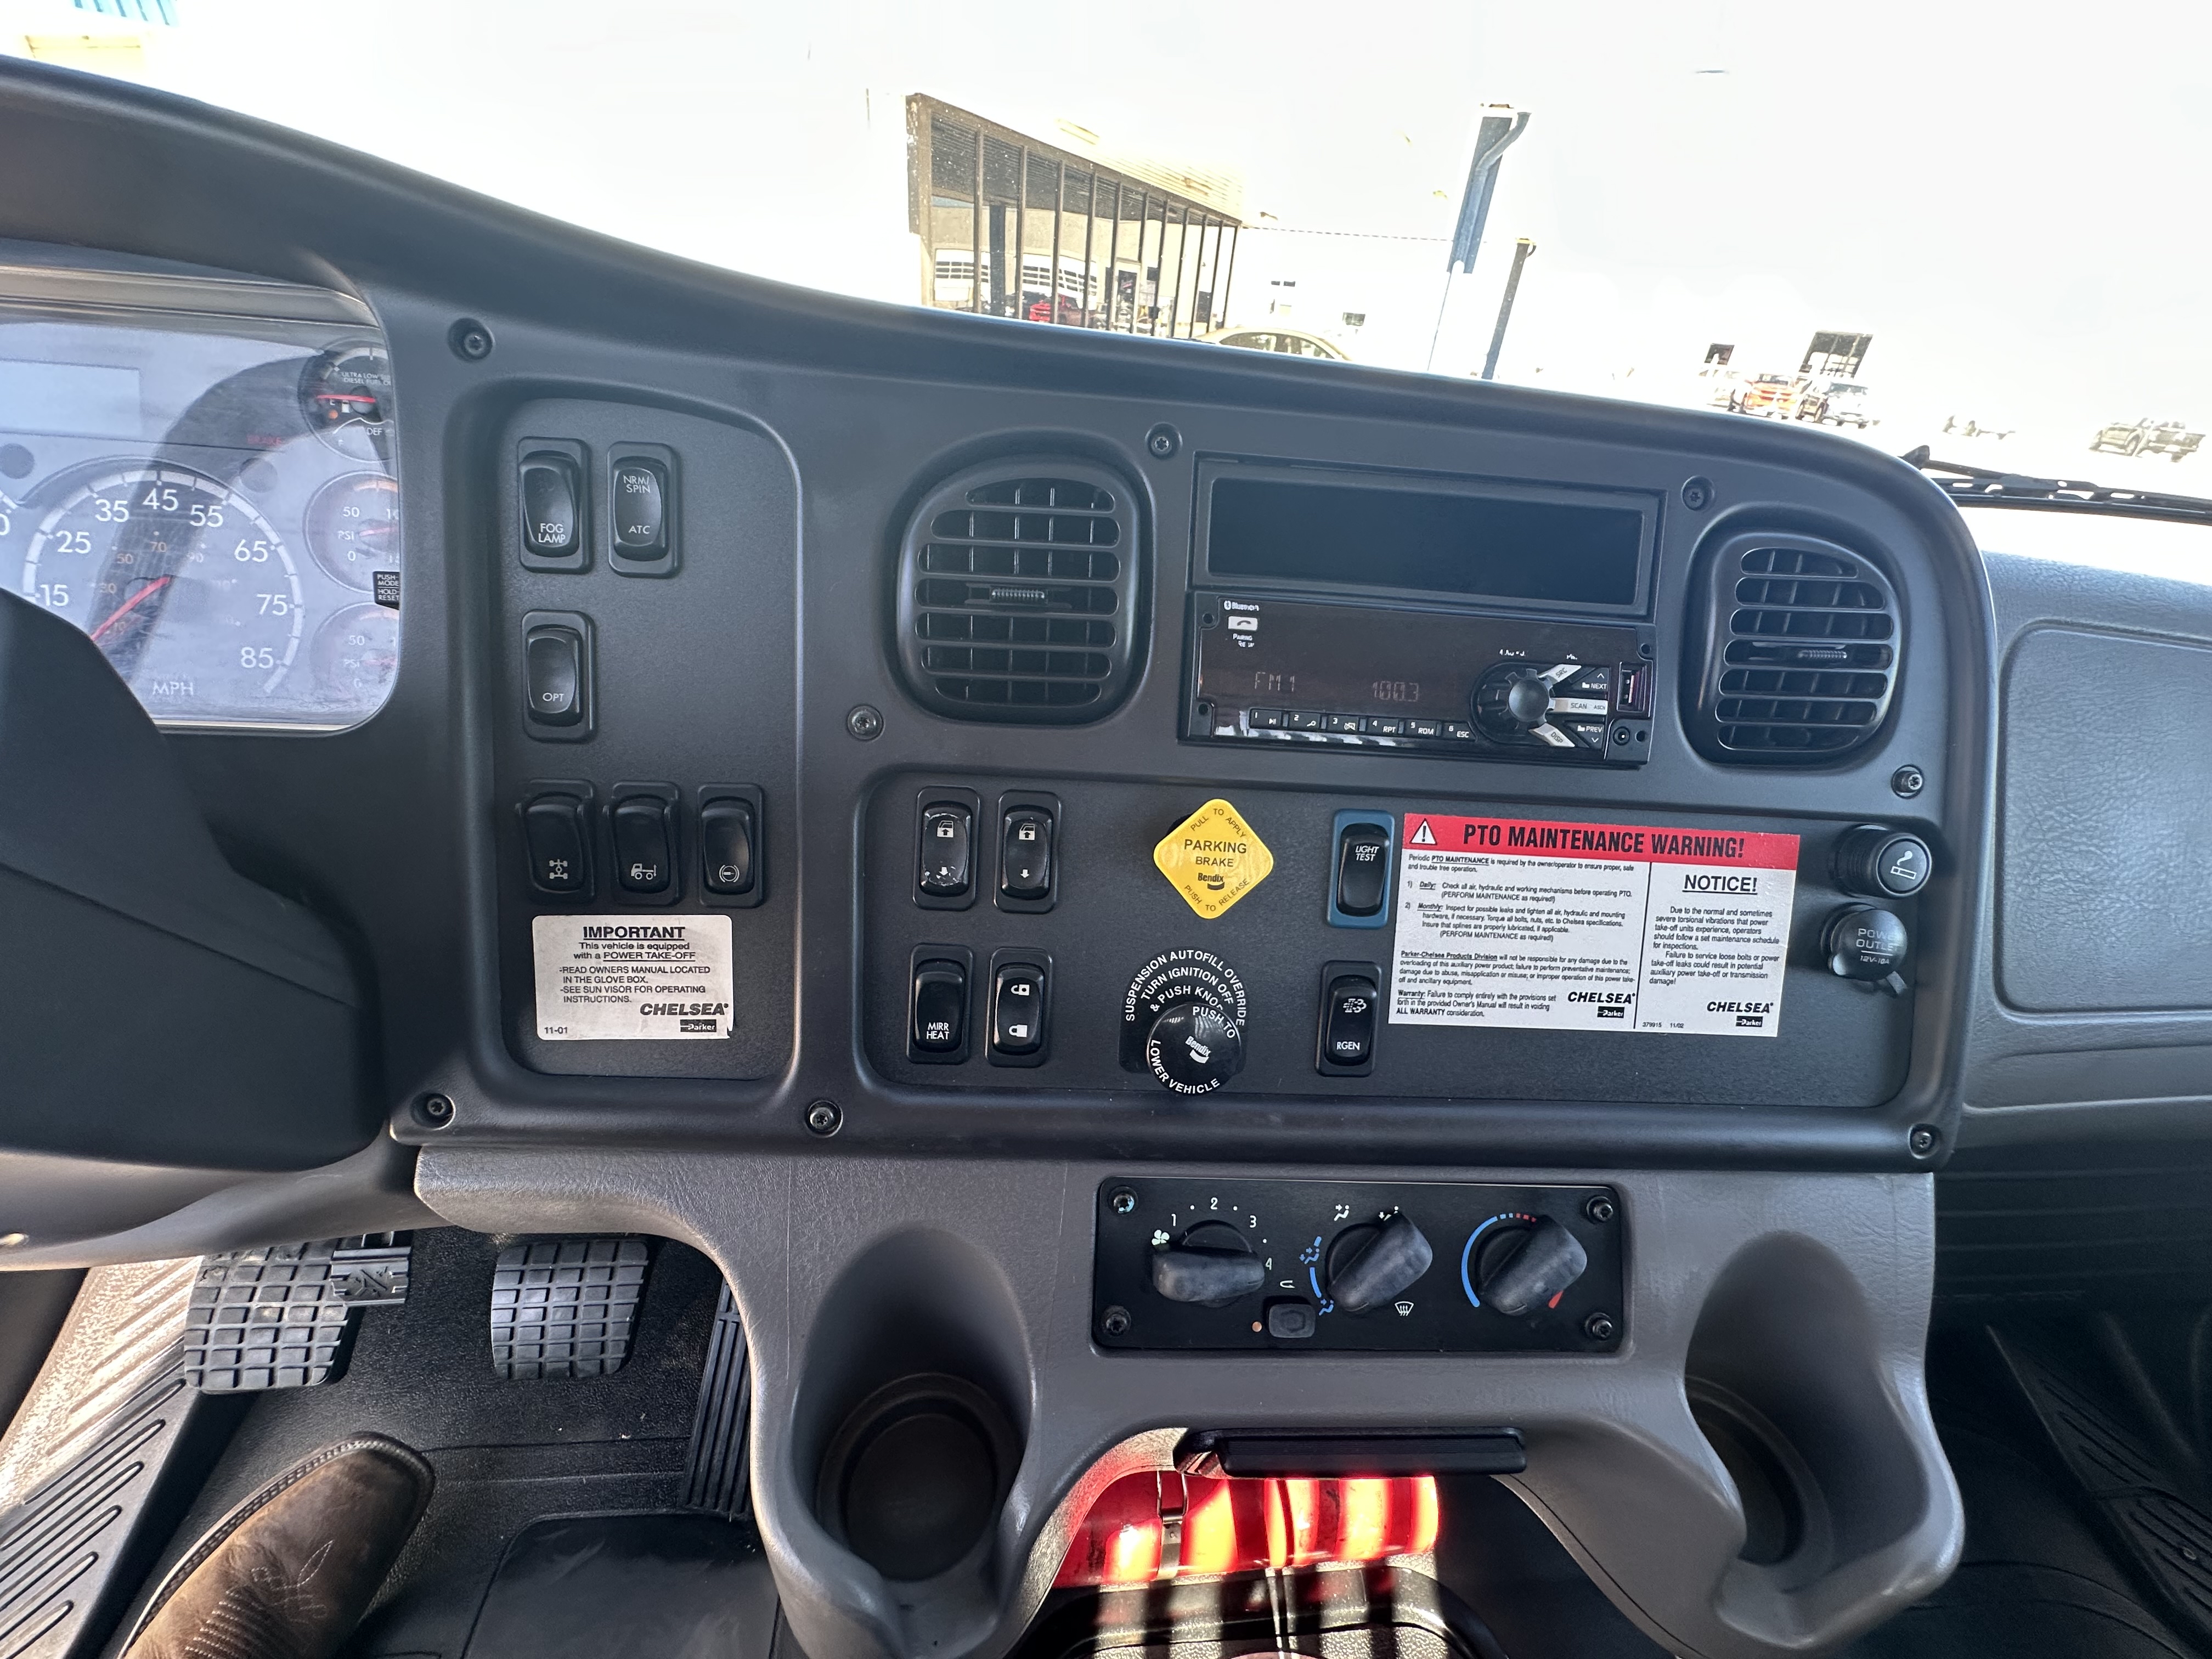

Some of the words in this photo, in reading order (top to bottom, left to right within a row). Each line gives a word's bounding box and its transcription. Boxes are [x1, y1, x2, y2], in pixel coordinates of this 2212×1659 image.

[366, 427, 382, 436] DEF
[623, 476, 650, 486] NRM/
[626, 484, 651, 494] SPIN
[143, 489, 178, 510] 45
[95, 500, 129, 522] 35
[189, 505, 224, 528] 55
[343, 506, 360, 517] 50
[540, 523, 563, 533] FOG
[628, 525, 650, 534] ATC
[338, 531, 354, 540] PSI
[538, 533, 566, 543] LAMP
[57, 531, 91, 554] 25
[150, 542, 167, 552] 70
[234, 540, 268, 562] 65
[347, 551, 356, 561] 0
[117, 554, 133, 564] 50
[40, 584, 69, 606] 15
[256, 594, 288, 616] 75
[348, 635, 365, 646] 50
[240, 647, 274, 669] 85
[1555, 667, 1568, 678] SRC
[153, 682, 194, 695] MPH
[542, 693, 564, 701] OPT
[1550, 731, 1563, 743] DISP
[1190, 816, 1210, 832] PULL
[1225, 817, 1246, 838] APPLY
[1184, 839, 1247, 854] PARKING
[1463, 824, 1500, 845] PTO
[1508, 826, 1645, 853] MAINTENANCE
[1651, 834, 1745, 858] WARNING!
[1356, 845, 1379, 854] LIGHT
[1195, 856, 1234, 867] BRAKE
[1356, 853, 1376, 862] TEST
[1198, 872, 1224, 882] Bendix
[1684, 873, 1757, 892] NOTICE!
[1184, 885, 1203, 904] PUSH
[1218, 878, 1250, 906] RELEASE
[1441, 890, 1475, 899] (PERFORM
[1475, 892, 1520, 901] MAINTENANCE
[1528, 895, 1556, 904] required!)
[1677, 915, 1704, 924] torsional
[1705, 916, 1735, 925] vibrations
[583, 926, 685, 938] IMPORTANT
[1654, 923, 1678, 932] take-off
[1695, 926, 1731, 934] experience,
[1653, 932, 1675, 940] should
[1675, 933, 1694, 941] follow
[1752, 936, 1780, 944] schedule
[647, 943, 690, 952] equipped
[1662, 942, 1699, 950] inspections.
[1860, 955, 1889, 964] 12V-10A
[1125, 954, 1167, 1022] SUSPENSION
[1170, 950, 1224, 971] AUTOFILL
[1224, 968, 1247, 1026] OVERRIDE
[1141, 973, 1168, 1000] TURN
[1168, 967, 1219, 986] IGNITION
[1217, 984, 1234, 1004] OFF
[1150, 1004, 1160, 1012] &
[1158, 985, 1191, 1004] PUSH
[1567, 991, 1632, 1004] CHELSEA
[640, 1003, 725, 1016] CHELSEA
[1409, 1007, 1446, 1015] WARRANTY
[1446, 1009, 1485, 1017] consideration.
[1706, 1001, 1770, 1013] CHELSEA
[688, 1022, 716, 1031] Parker
[928, 1023, 950, 1031] MIRR
[1193, 1006, 1224, 1025] PUSH
[1223, 1022, 1236, 1039] TO
[926, 1030, 950, 1040] HEAT
[1185, 1036, 1211, 1057] Bendix
[1336, 1041, 1361, 1051] RGEN
[1150, 1040, 1169, 1082] LOWER
[1169, 1078, 1221, 1094] VEHICLE
[1211, 1197, 1218, 1210] 2
[1171, 1214, 1176, 1227] 1
[1250, 1215, 1257, 1228] 3
[1266, 1257, 1273, 1270] 4
